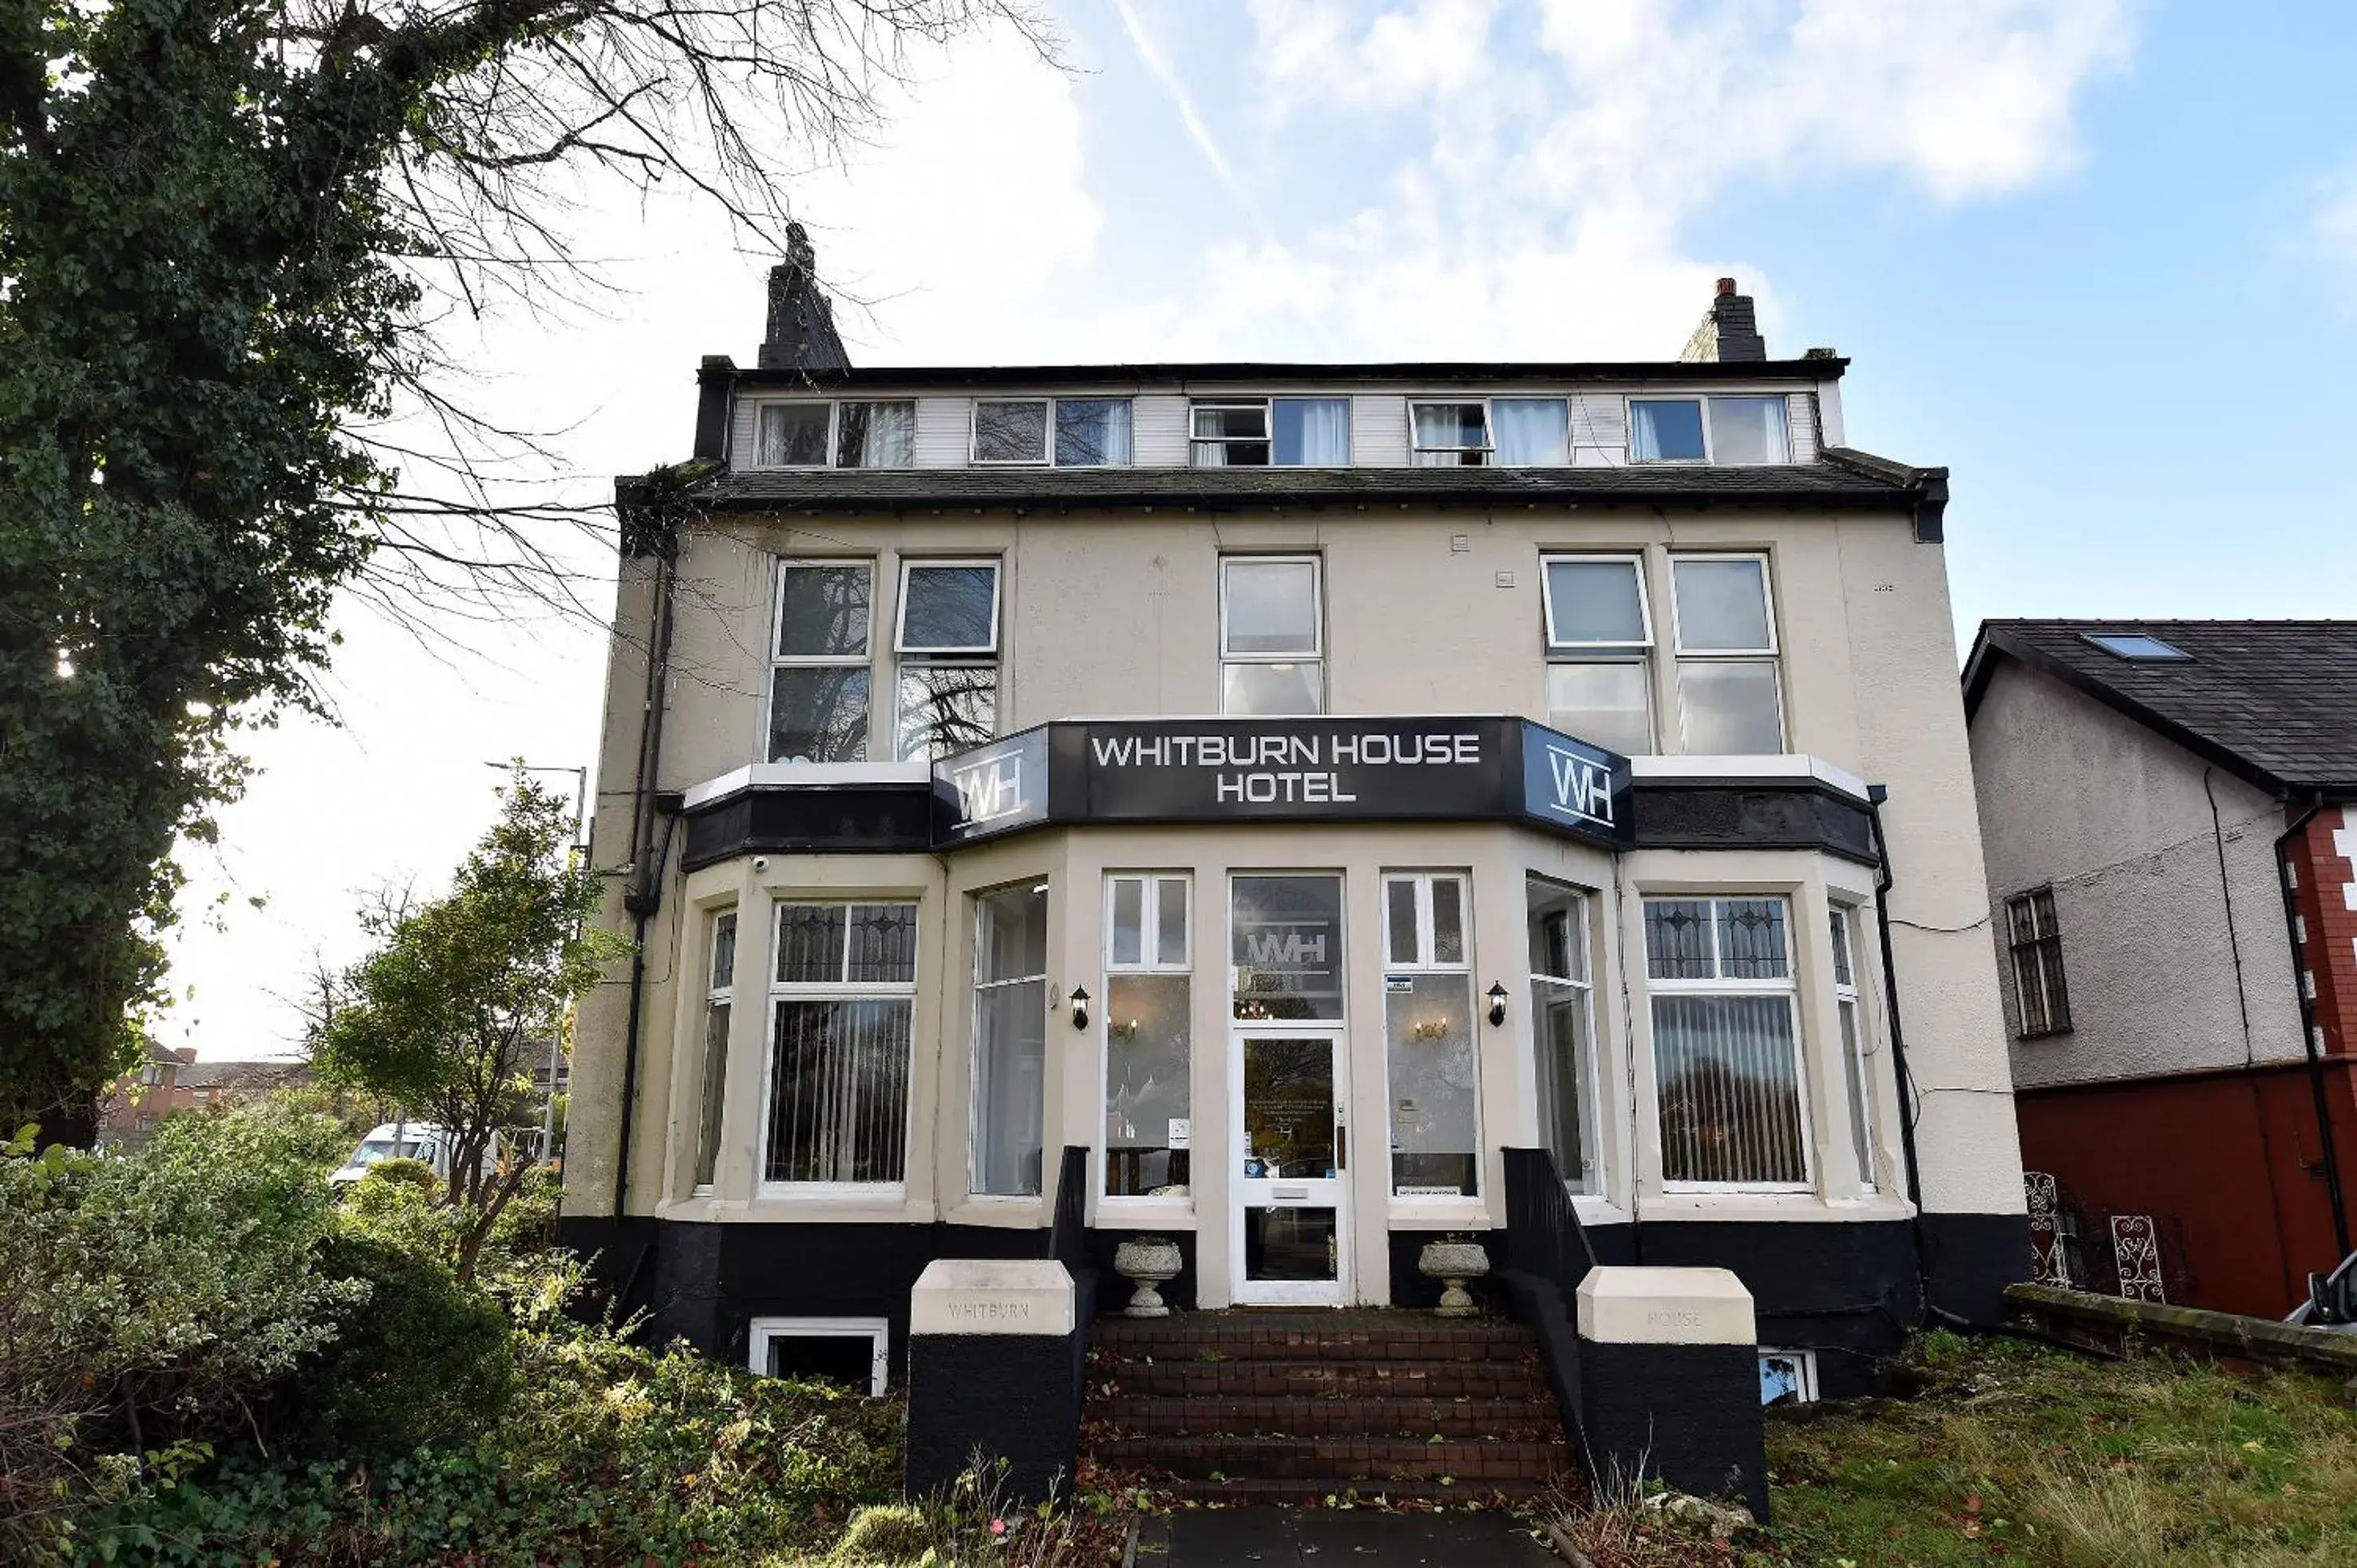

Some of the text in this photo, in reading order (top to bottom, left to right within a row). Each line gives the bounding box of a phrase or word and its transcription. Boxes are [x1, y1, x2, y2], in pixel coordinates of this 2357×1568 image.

[1092, 734, 1480, 766] WHITBURN HOUSE
[954, 756, 1021, 822] WH
[1217, 772, 1357, 803] HOTEL
[1548, 750, 1613, 821] WH
[1247, 934, 1326, 962] WH
[947, 1302, 1030, 1319] WHITBURN
[1647, 1311, 1704, 1327] HOUSE
